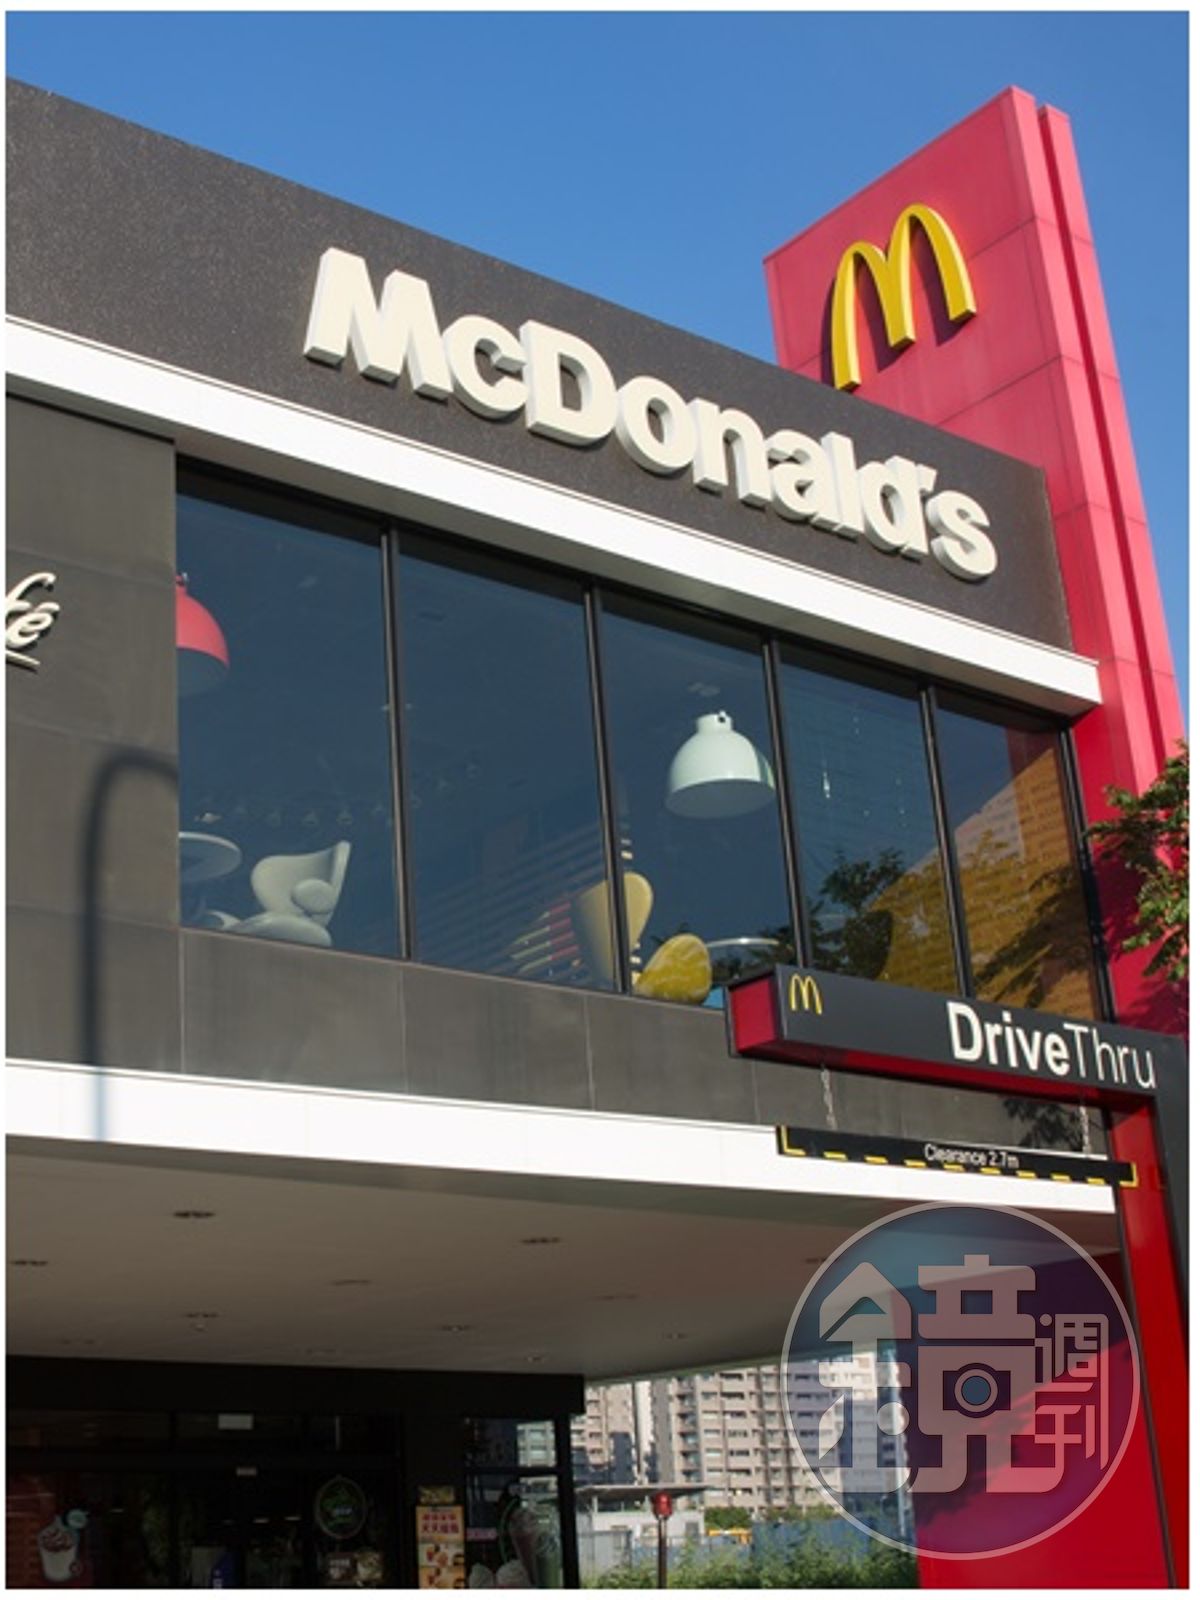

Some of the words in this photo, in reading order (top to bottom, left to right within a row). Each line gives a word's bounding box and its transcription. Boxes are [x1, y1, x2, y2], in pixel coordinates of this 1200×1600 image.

[303, 246, 998, 581] McDonald's
[924, 1143, 987, 1166] Clearance
[988, 1150, 1020, 1169] 2.7m
